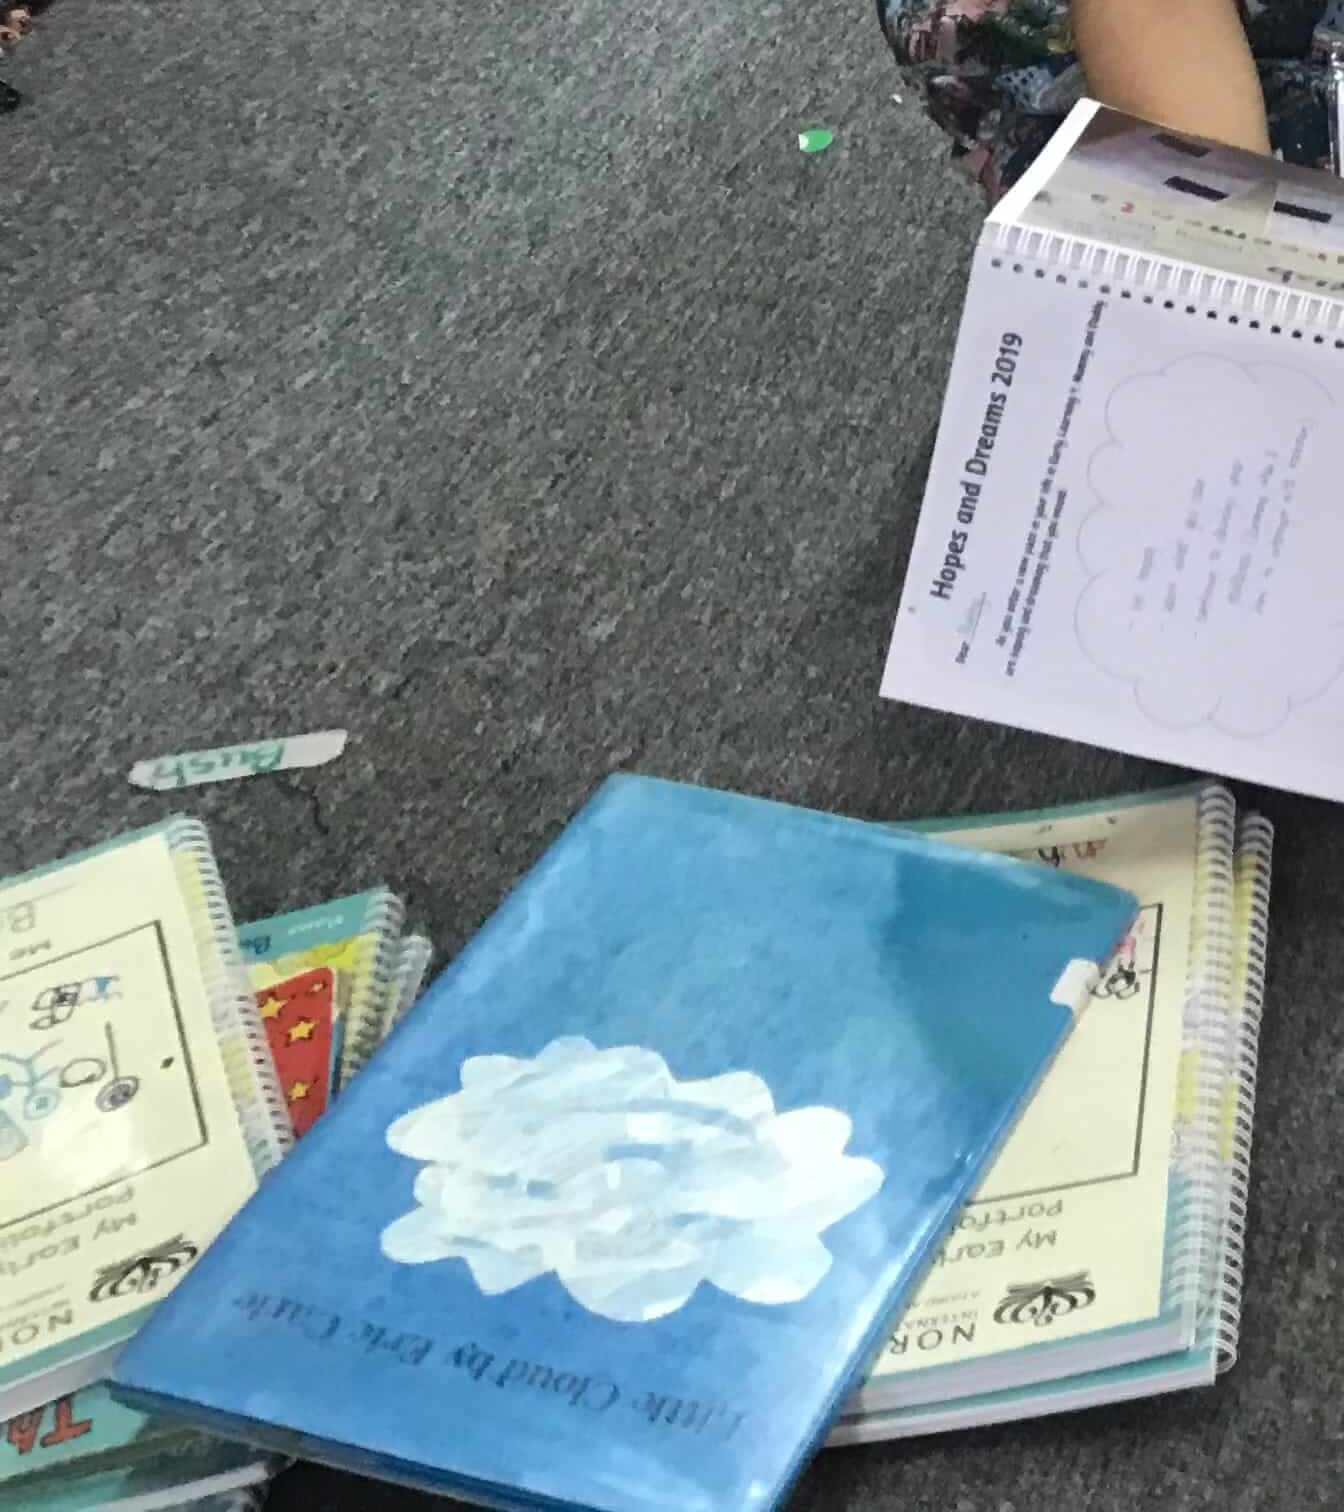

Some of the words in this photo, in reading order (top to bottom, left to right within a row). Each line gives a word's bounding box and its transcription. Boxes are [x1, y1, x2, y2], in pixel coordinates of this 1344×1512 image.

[990, 331, 1023, 386] 2019
[964, 390, 1008, 476] Dreams
[955, 479, 982, 524] and
[929, 529, 968, 600] Hopes
[1016, 1229, 1056, 1252] My
[450, 1341, 495, 1383] by
[496, 1355, 622, 1414] Cloud
